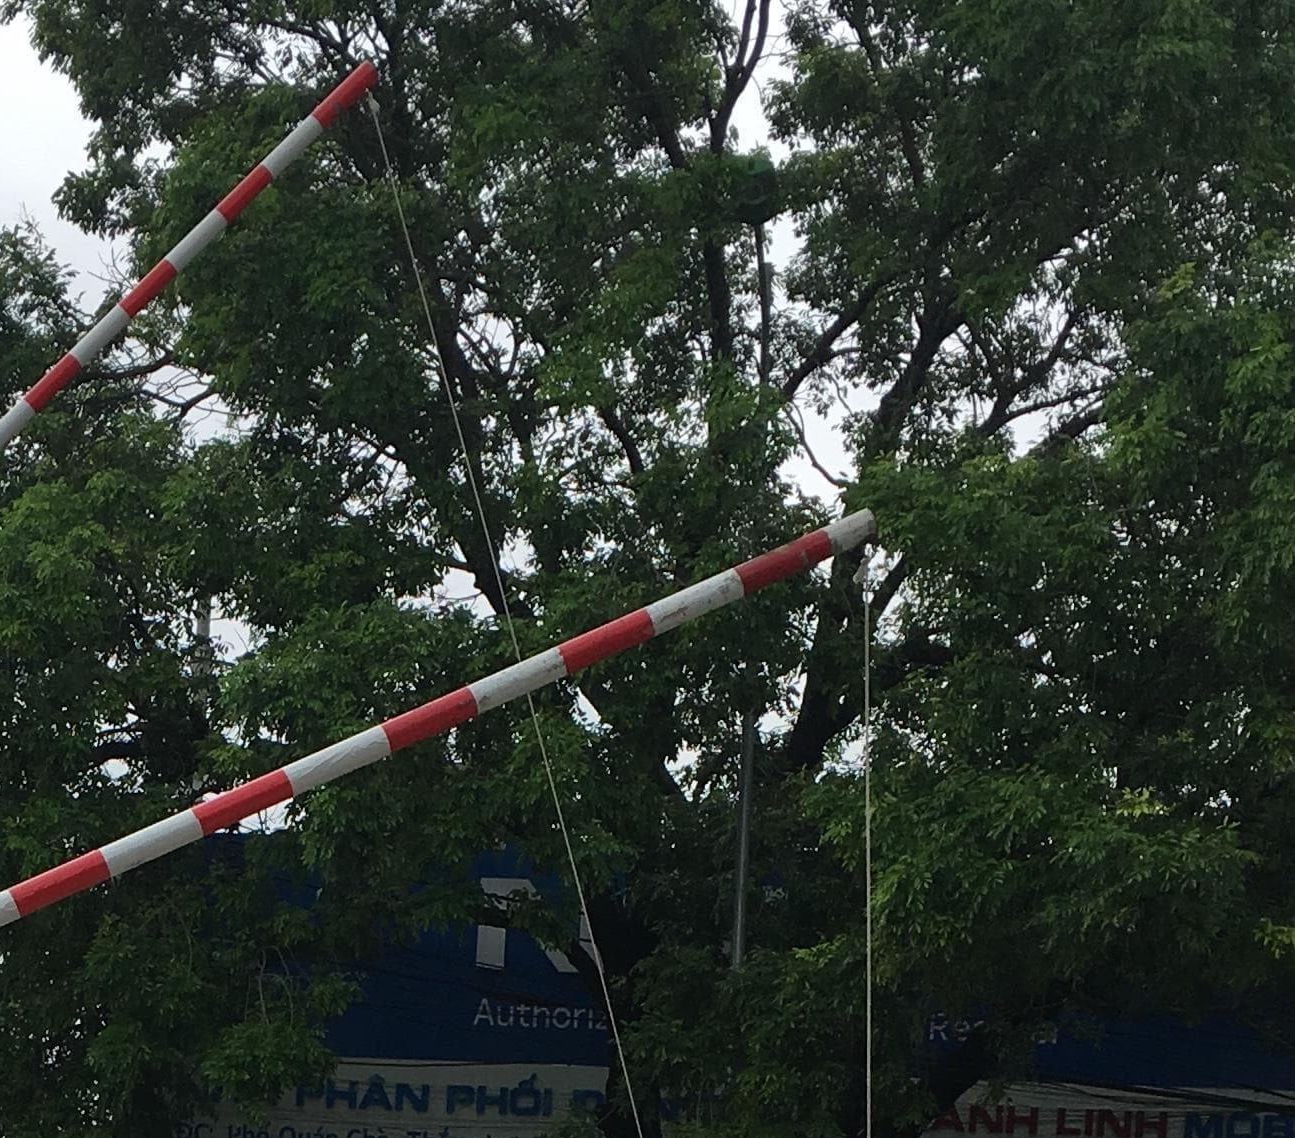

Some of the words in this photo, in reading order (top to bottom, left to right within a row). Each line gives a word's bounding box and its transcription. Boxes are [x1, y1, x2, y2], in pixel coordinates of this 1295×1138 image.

[473, 997, 608, 1032] Authoriz
[296, 1073, 432, 1119] PHÂN
[446, 1072, 555, 1118] PHỐI
